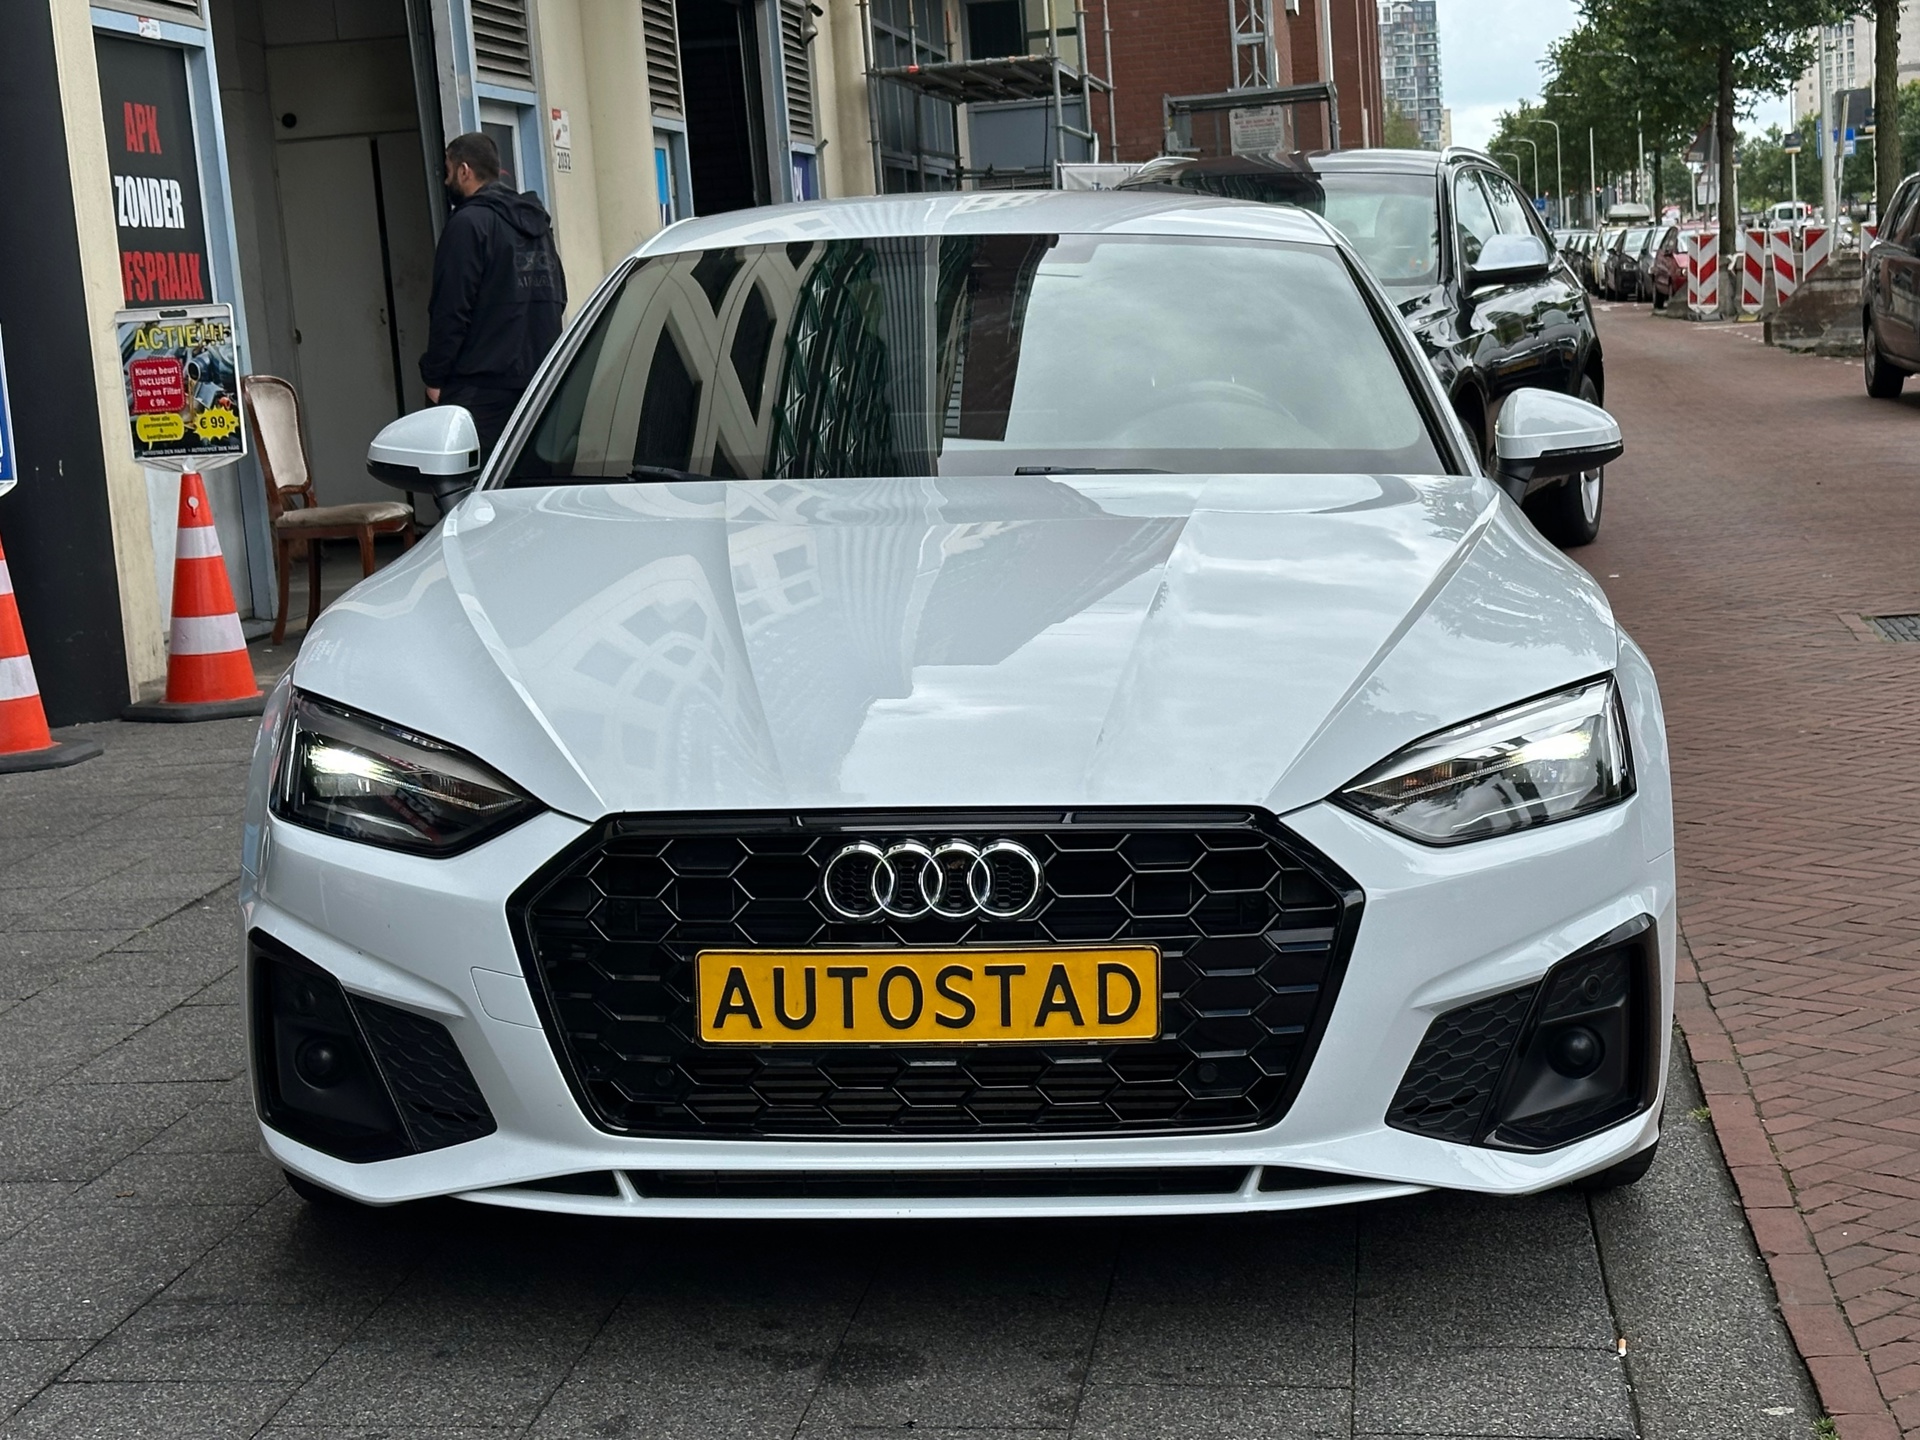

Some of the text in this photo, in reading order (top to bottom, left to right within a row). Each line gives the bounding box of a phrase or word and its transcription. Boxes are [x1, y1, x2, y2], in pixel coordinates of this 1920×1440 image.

[123, 102, 162, 155] APK
[114, 175, 185, 229] ZONDER
[122, 251, 204, 301] FSPRAAK
[134, 323, 226, 351] ACTIE!!!
[135, 366, 178, 376] Kleine beurt
[139, 376, 176, 386] INCLUSIEF
[136, 389, 151, 397] Olie
[163, 387, 181, 395] Filter
[200, 416, 236, 430] € 99,-
[712, 963, 1142, 1030] AUTOSTAD
